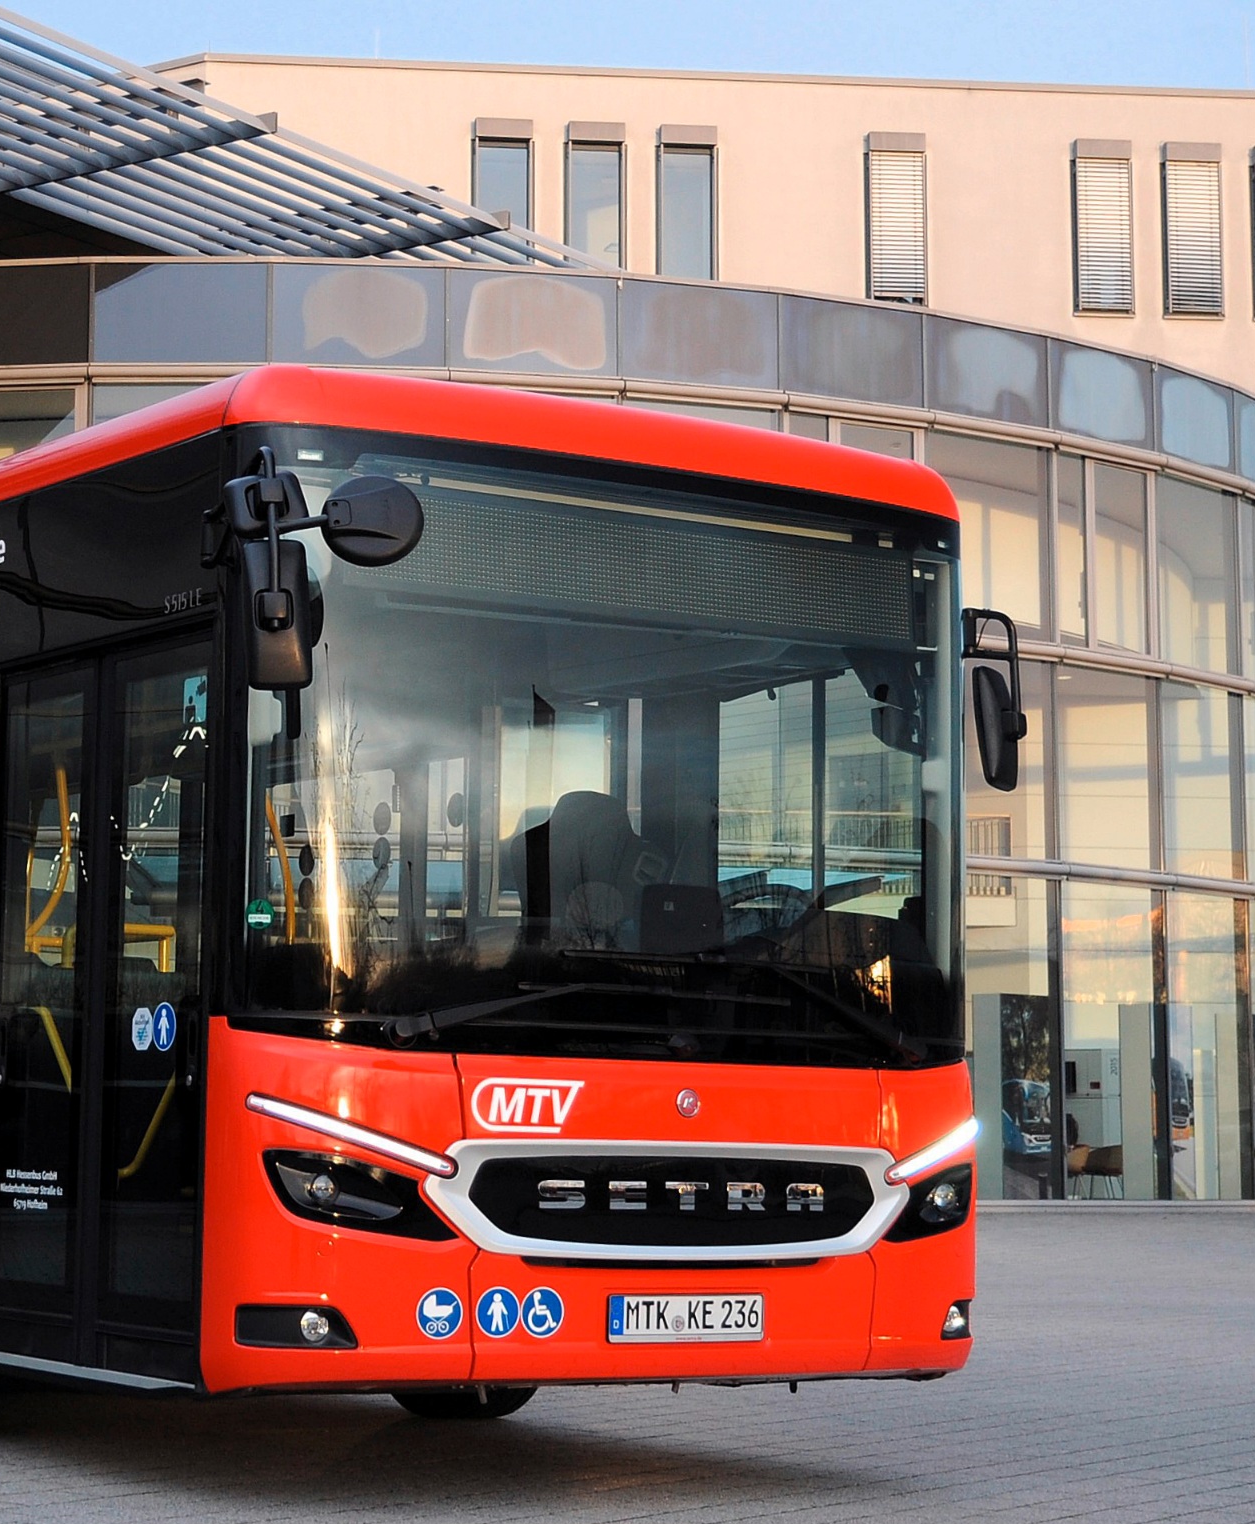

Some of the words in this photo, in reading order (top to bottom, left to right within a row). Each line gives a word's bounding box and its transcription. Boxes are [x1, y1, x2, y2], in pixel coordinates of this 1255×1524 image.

[190, 588, 202, 607] LE
[488, 1081, 582, 1125] MTV
[538, 1180, 824, 1211] SETRA
[613, 1320, 620, 1329] D
[626, 1301, 669, 1329] MTK
[688, 1301, 714, 1329] KE
[721, 1300, 759, 1329] 236
